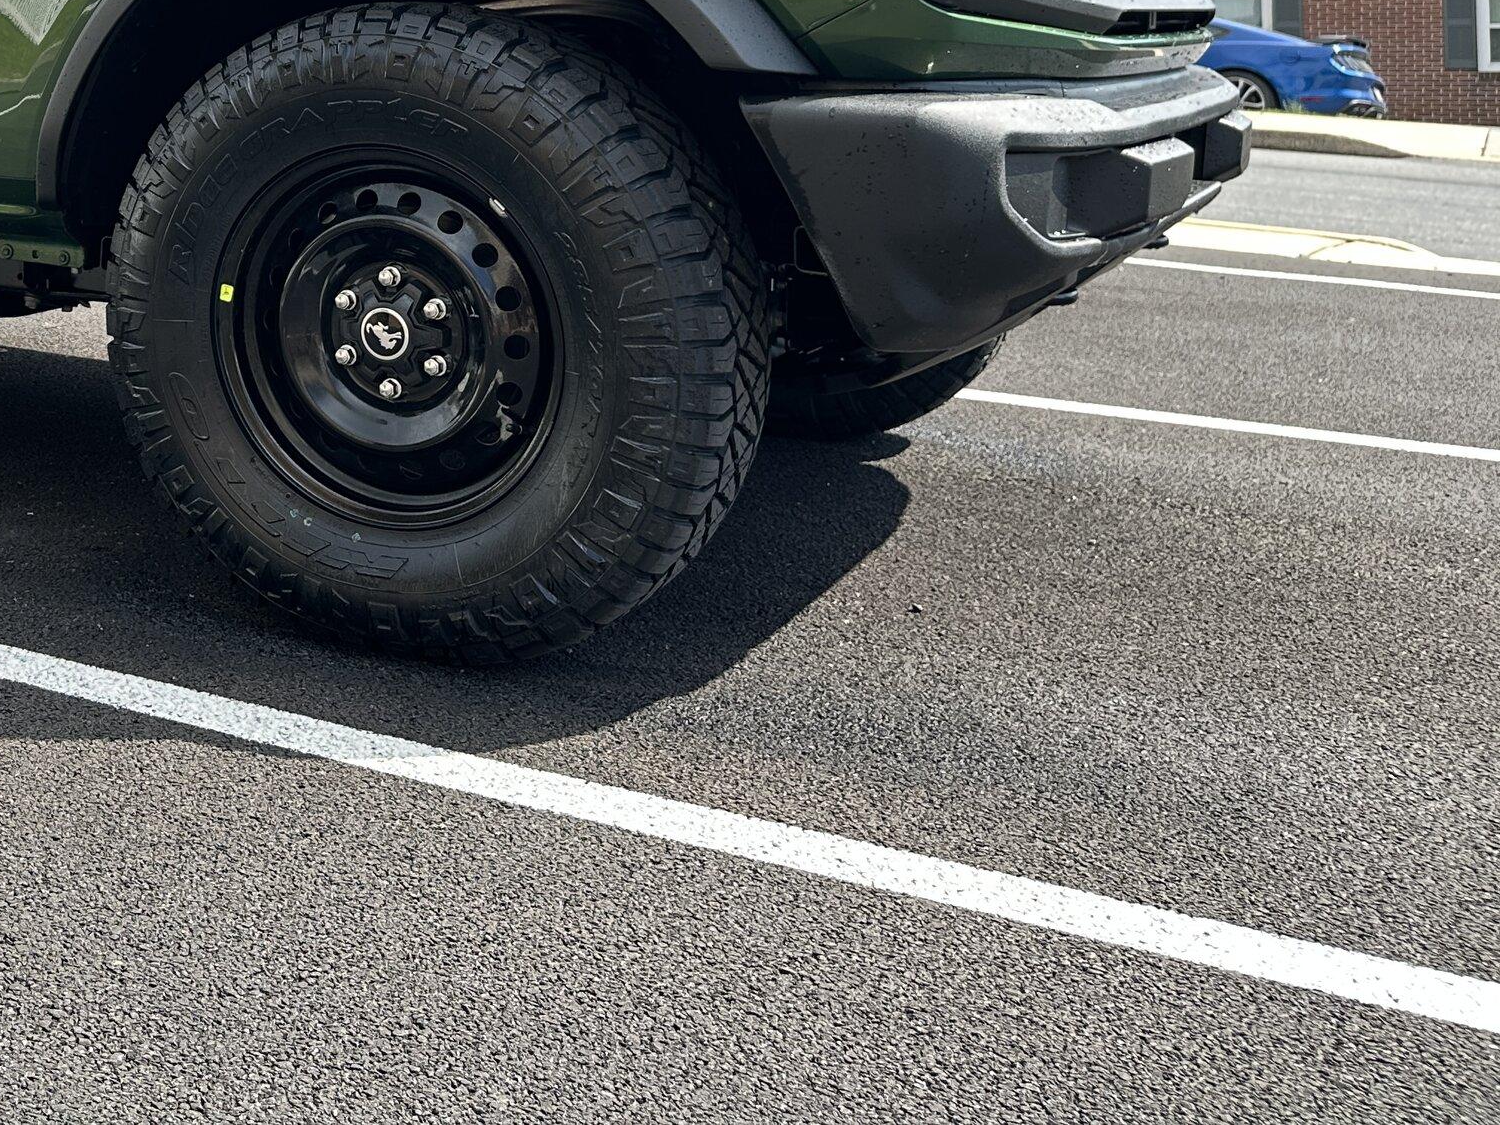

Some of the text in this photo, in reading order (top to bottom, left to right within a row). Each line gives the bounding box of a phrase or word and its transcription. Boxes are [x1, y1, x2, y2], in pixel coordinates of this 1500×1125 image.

[167, 97, 469, 287] RIDGE GRAPPLER
[166, 371, 410, 580] NITTO
